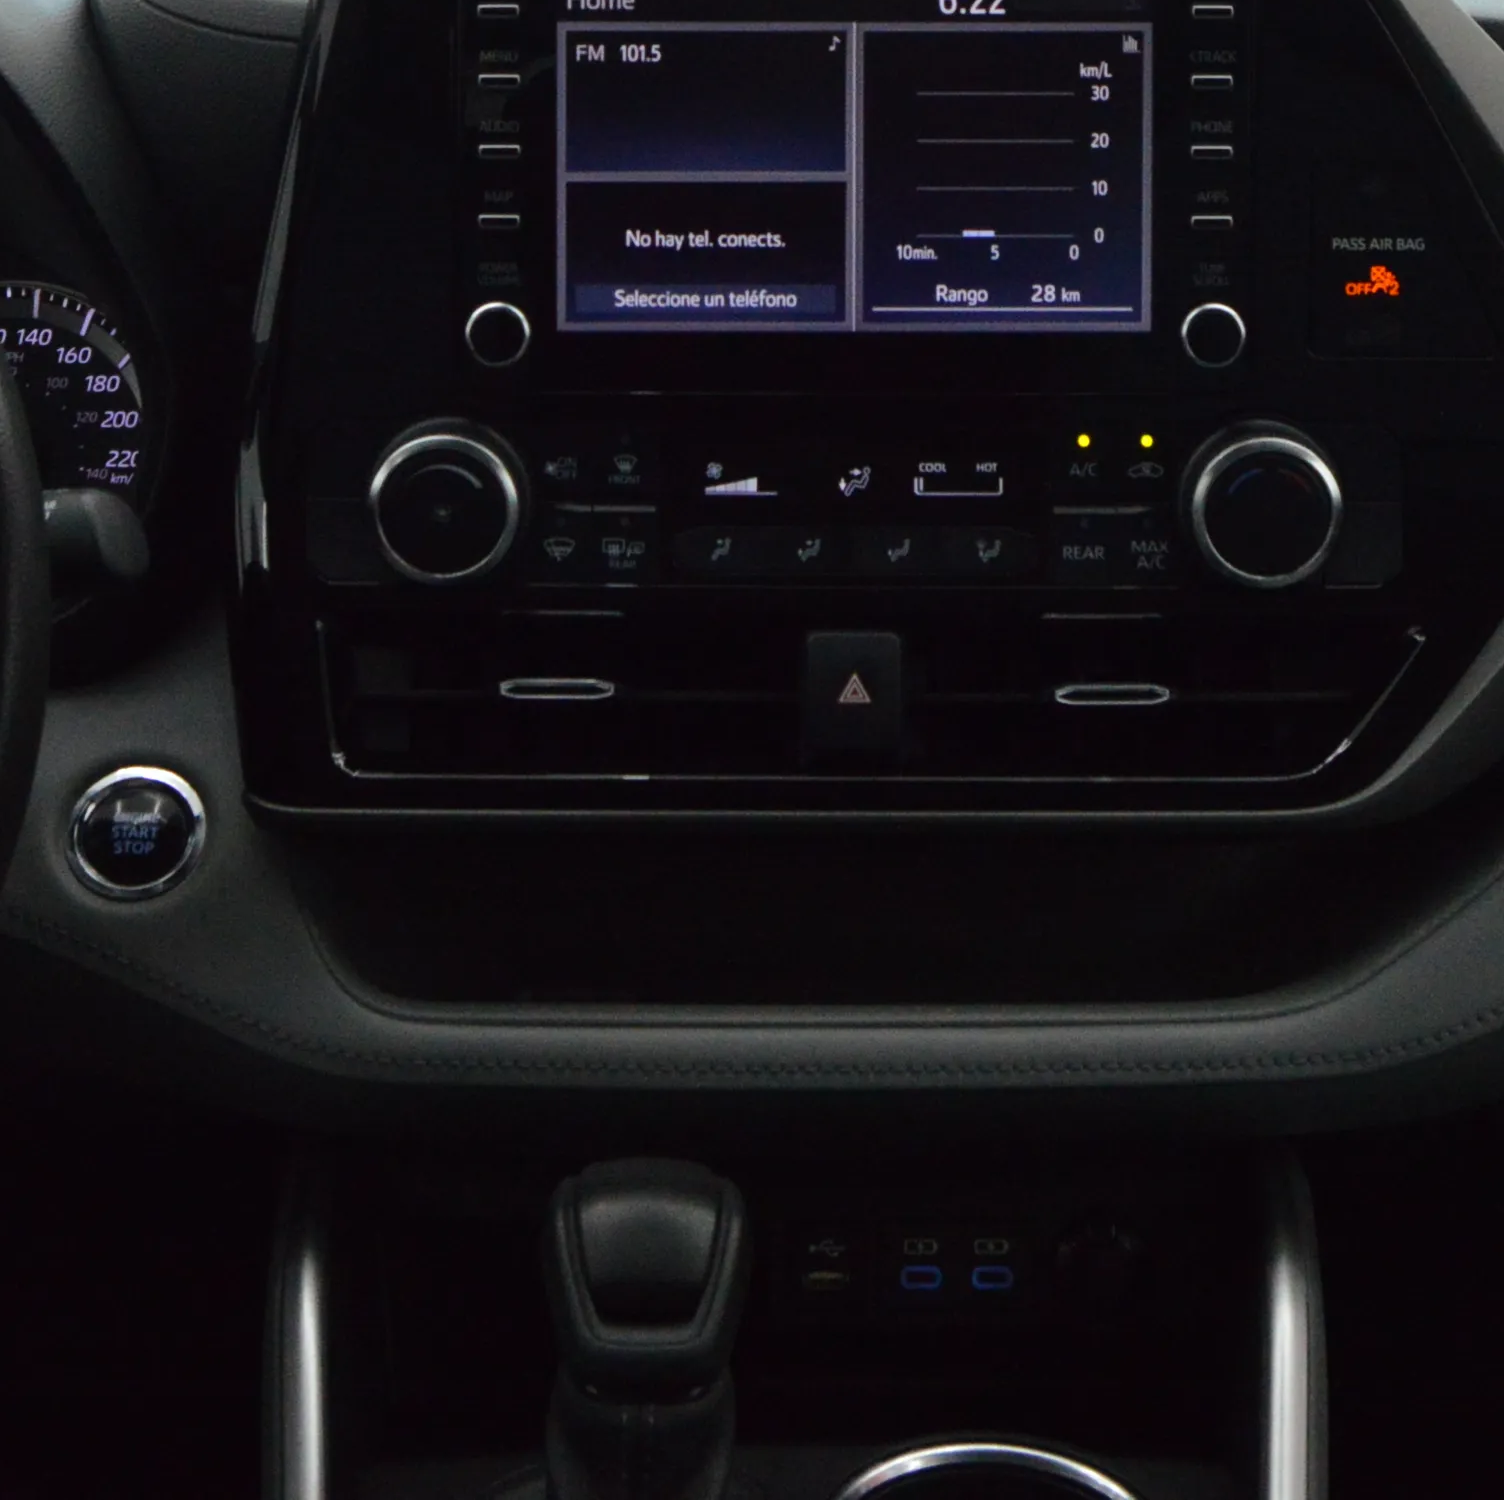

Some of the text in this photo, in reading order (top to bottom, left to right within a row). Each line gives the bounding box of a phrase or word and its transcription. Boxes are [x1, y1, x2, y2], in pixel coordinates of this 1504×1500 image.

[575, 44, 661, 63] FM 101.5
[1079, 61, 1113, 79] km/L
[1090, 85, 1110, 101] 30
[1090, 133, 1110, 148] 20
[1091, 180, 1108, 196] 10
[625, 229, 786, 252] No hay tel. conects.
[1094, 228, 1105, 243] 0
[1332, 237, 1426, 251] PASS AIR BAG
[896, 244, 1080, 260] 10min. 5 0
[614, 288, 797, 308] Seleccione un teléfono
[935, 285, 1081, 306] Rango 28 km
[15, 328, 53, 347] 140
[56, 347, 92, 365] 160
[46, 376, 69, 390] 100
[84, 374, 121, 393] 180
[76, 411, 98, 423] 120
[100, 410, 139, 429] 200
[86, 468, 108, 480] 140
[918, 462, 998, 473] COOL HOT
[1069, 463, 1098, 478] A/C
[109, 473, 134, 485] km/
[1062, 546, 1105, 560] REAR
[1130, 540, 1170, 554] MAX
[1137, 556, 1166, 570] A/C
[112, 825, 159, 839] START
[113, 841, 156, 856] STOP
